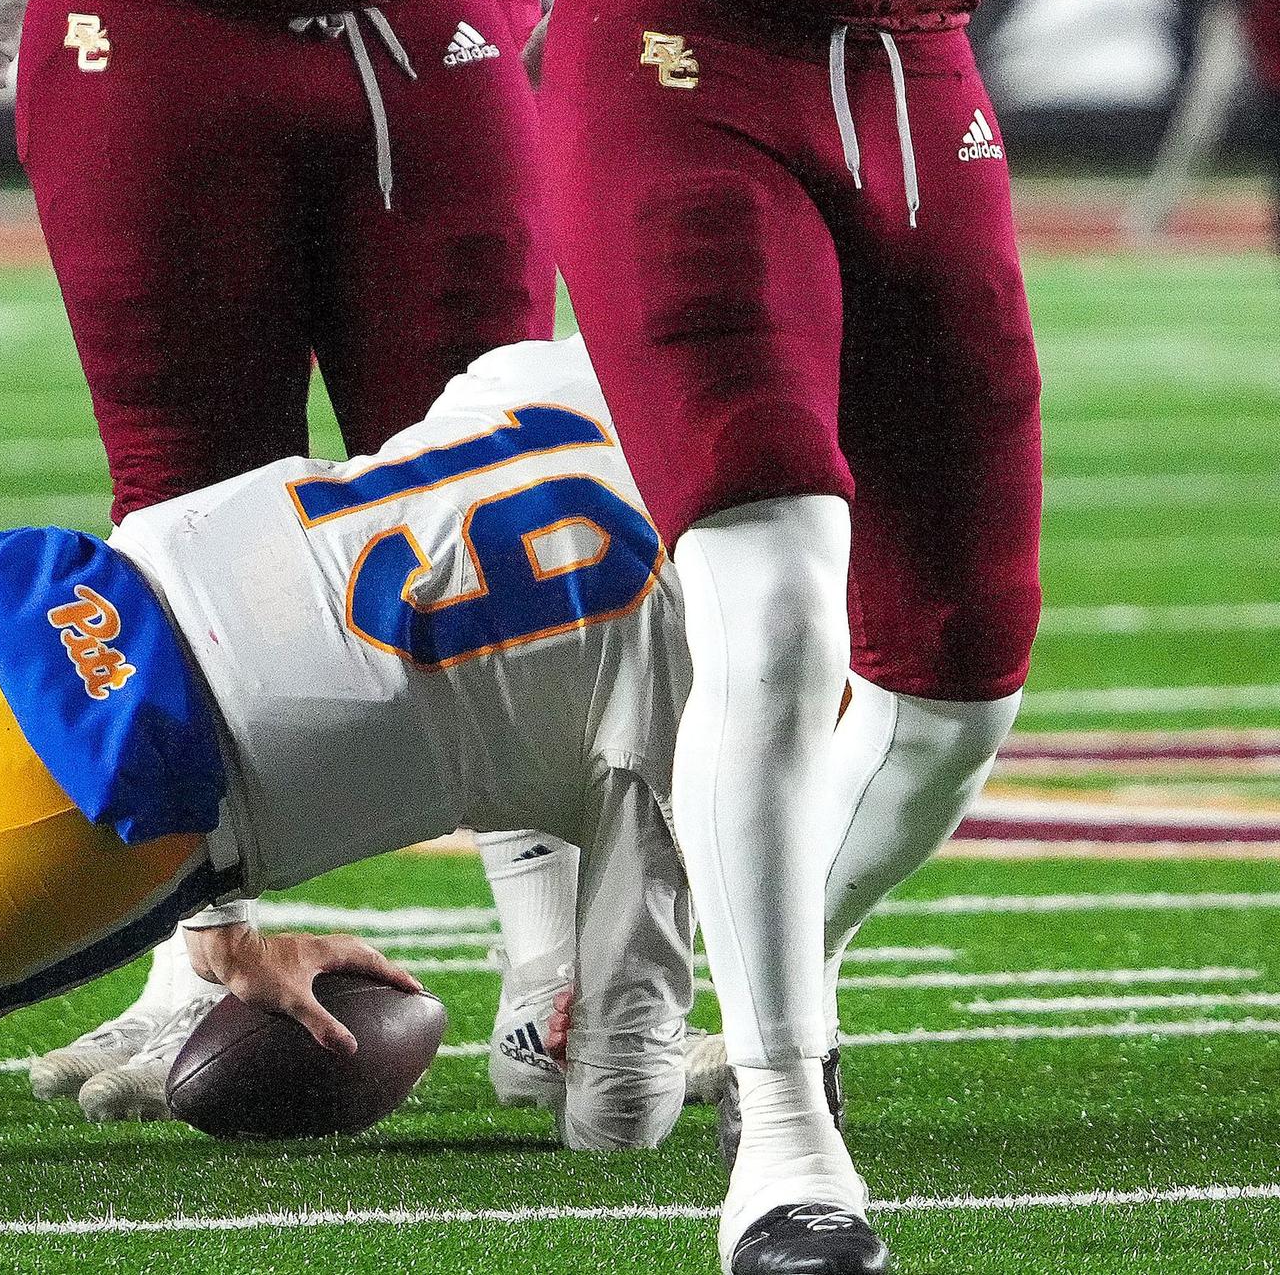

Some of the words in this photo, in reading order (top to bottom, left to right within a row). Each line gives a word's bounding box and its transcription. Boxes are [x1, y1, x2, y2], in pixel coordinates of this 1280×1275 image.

[443, 44, 501, 66] adidas
[958, 138, 1004, 161] adidas
[285, 402, 667, 673] 19
[47, 584, 136, 700] Pitt
